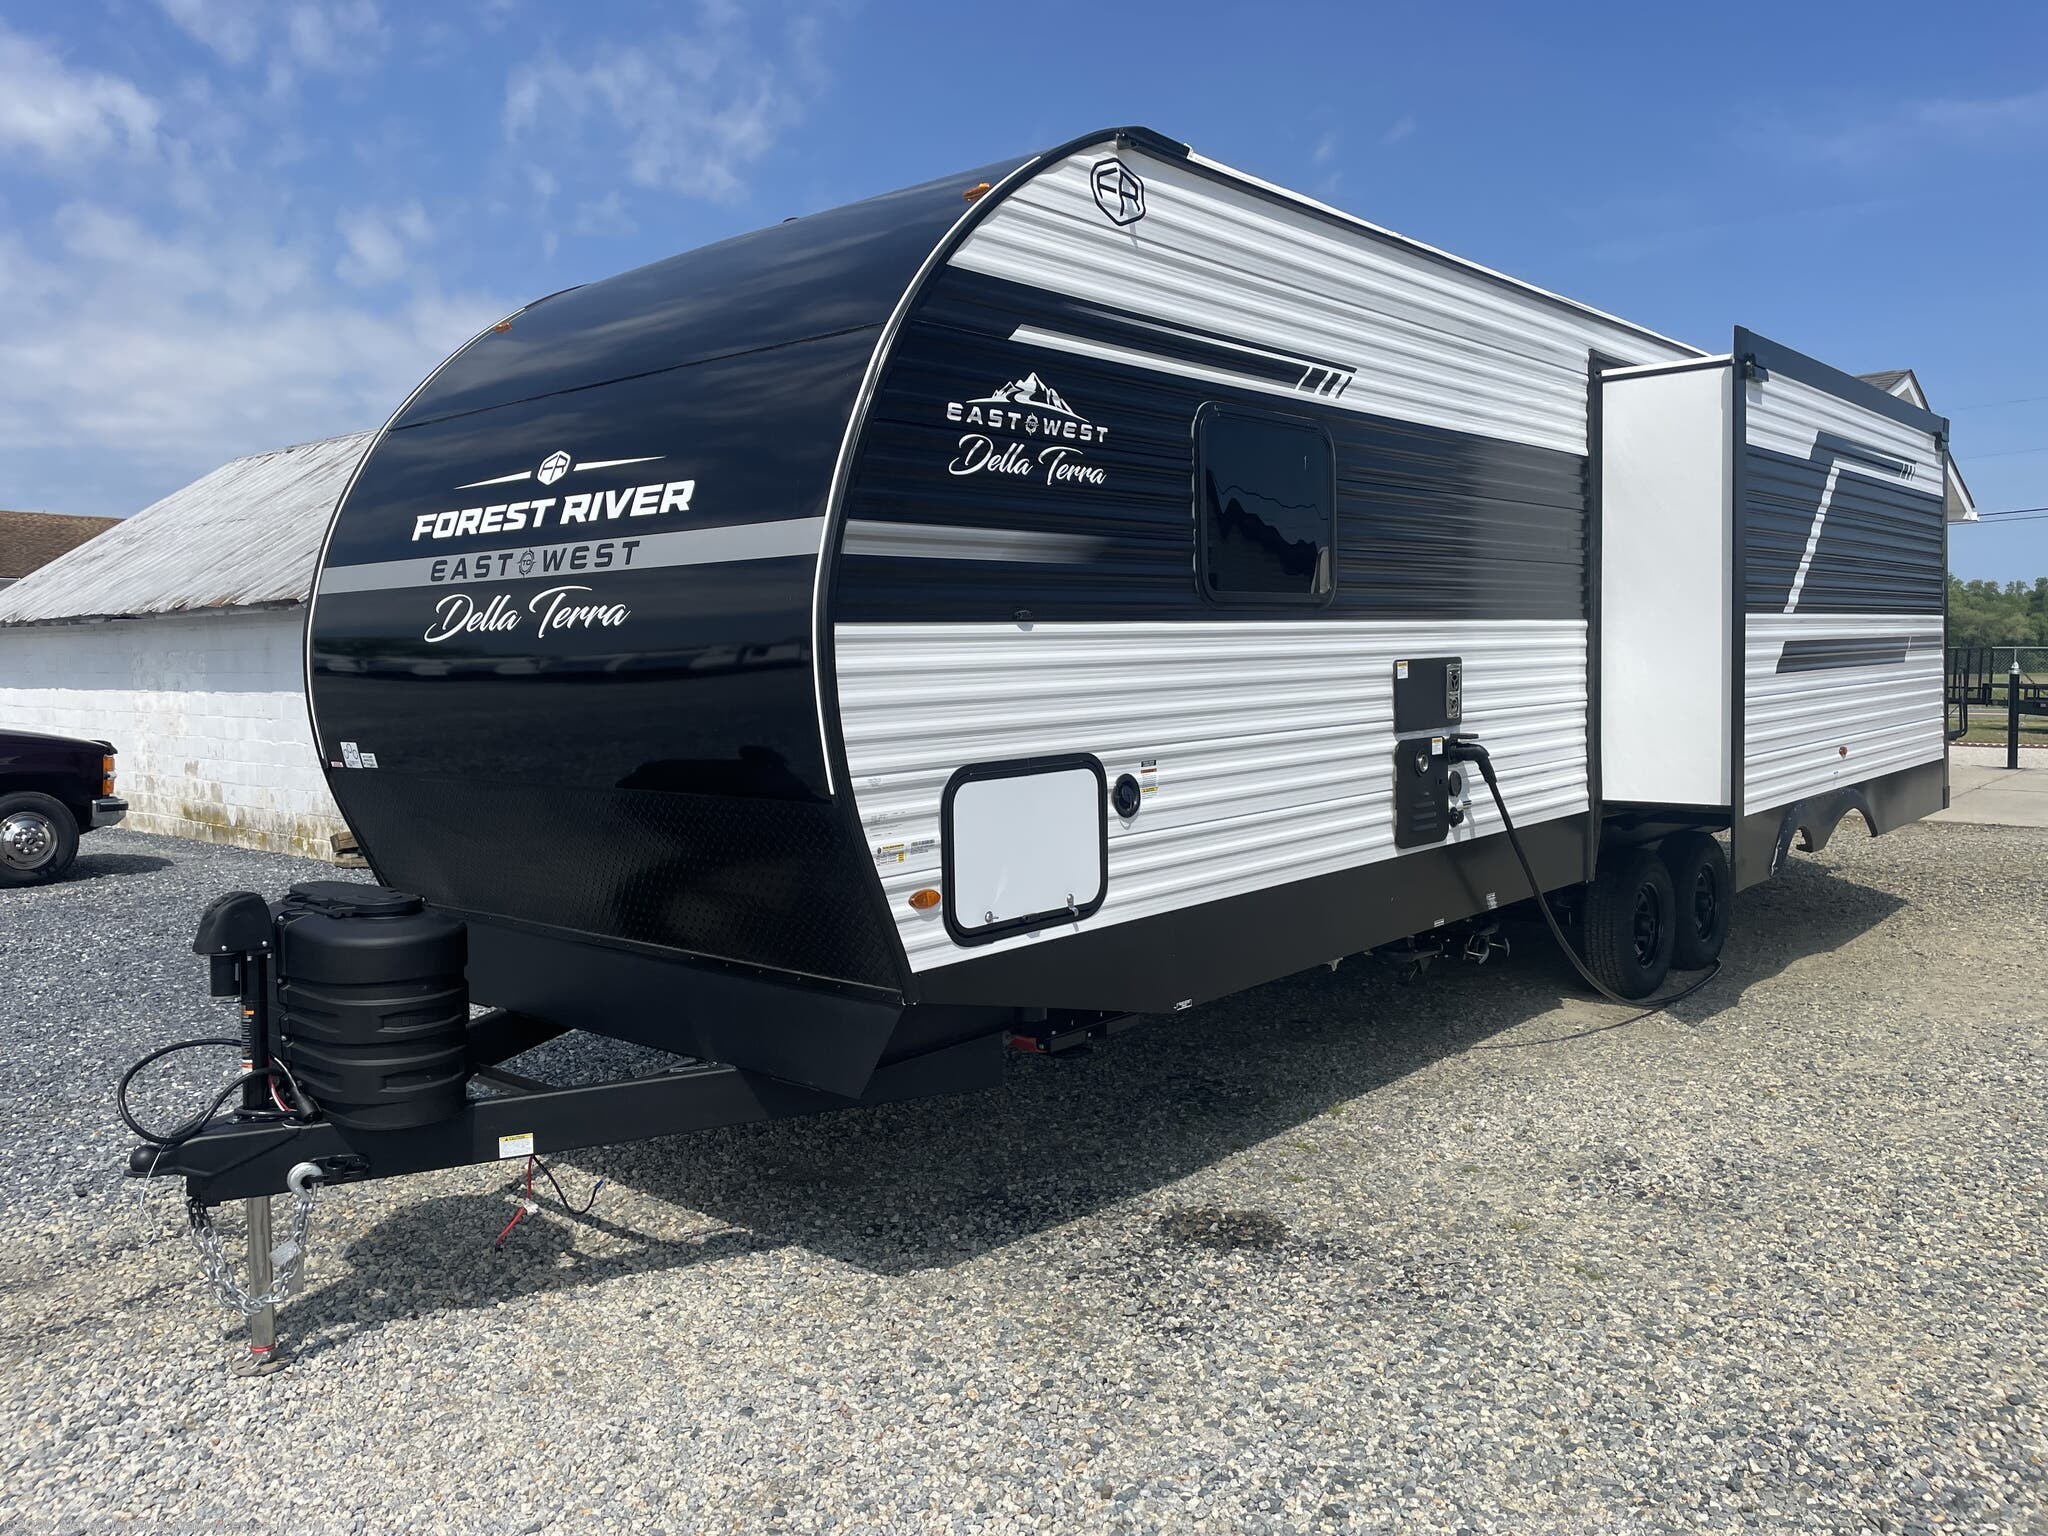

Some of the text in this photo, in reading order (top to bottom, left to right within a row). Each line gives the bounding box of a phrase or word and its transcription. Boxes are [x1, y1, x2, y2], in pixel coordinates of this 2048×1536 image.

[946, 401, 1022, 430] EAST
[1043, 417, 1109, 443] WEST
[948, 433, 1108, 486] Della Terra
[411, 479, 696, 541] FOREST RIVER
[430, 552, 514, 582] EAST
[542, 540, 640, 573] WEST
[423, 585, 632, 643] Della Terra
